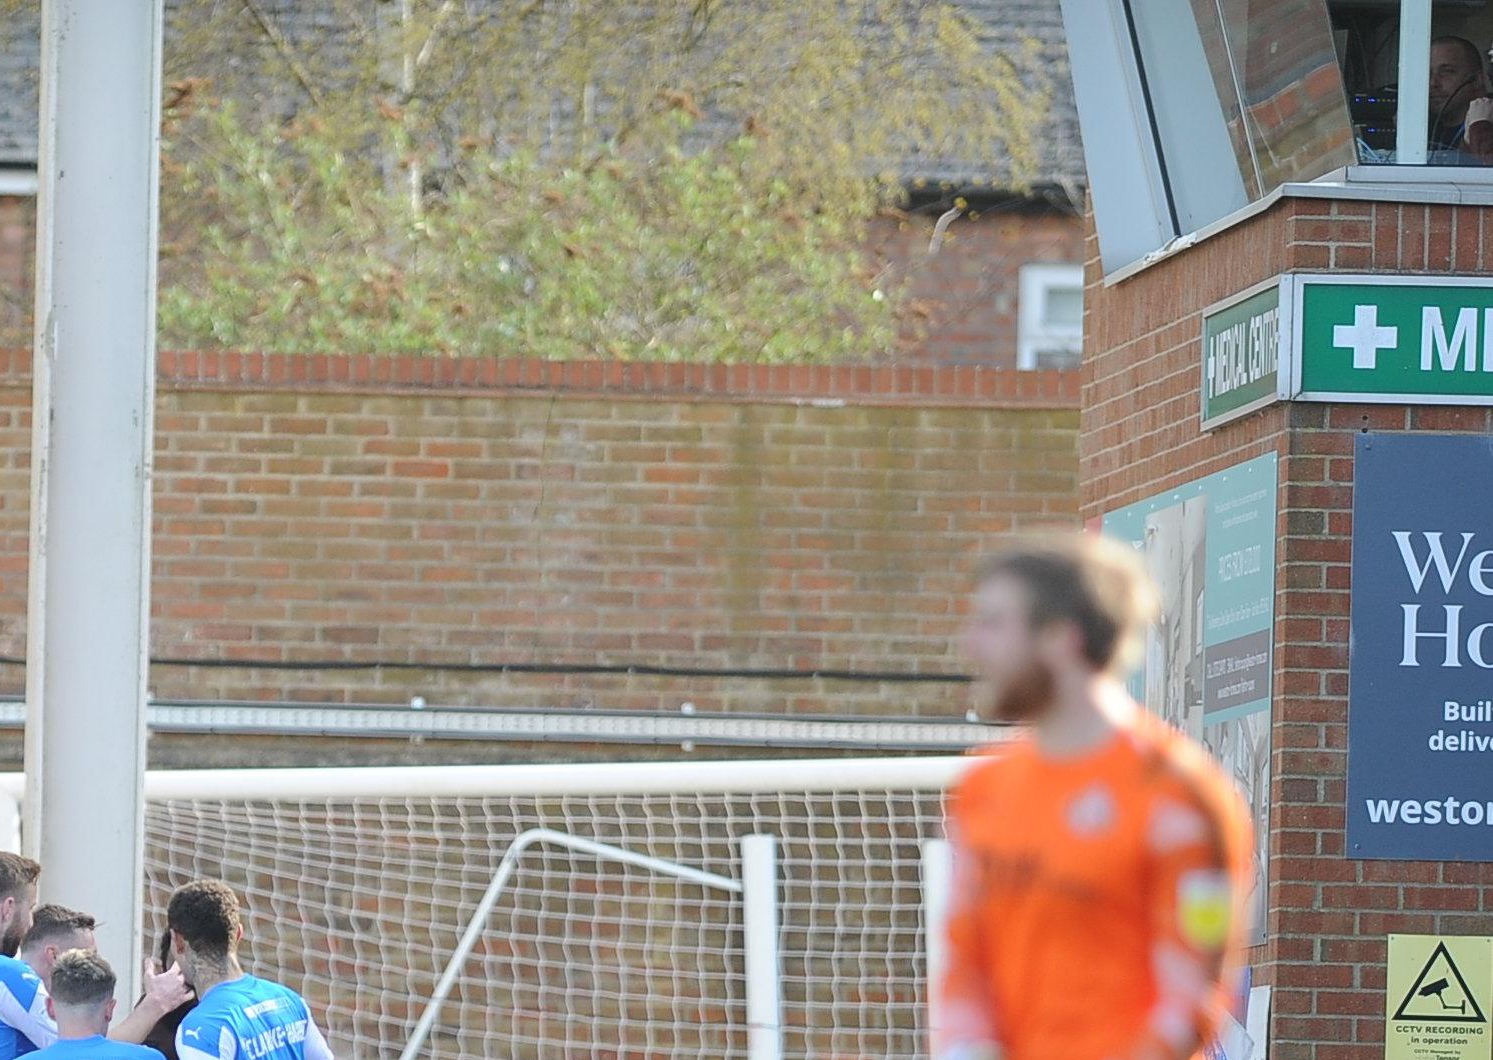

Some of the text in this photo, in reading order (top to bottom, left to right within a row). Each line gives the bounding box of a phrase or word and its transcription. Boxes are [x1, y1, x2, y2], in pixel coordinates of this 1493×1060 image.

[1420, 306, 1493, 372] M
[1215, 321, 1247, 398] MEDICAL
[1444, 701, 1493, 722] Buil
[1395, 1025, 1484, 1035] CCTV RECORDING
[1411, 1036, 1468, 1045] in operation
